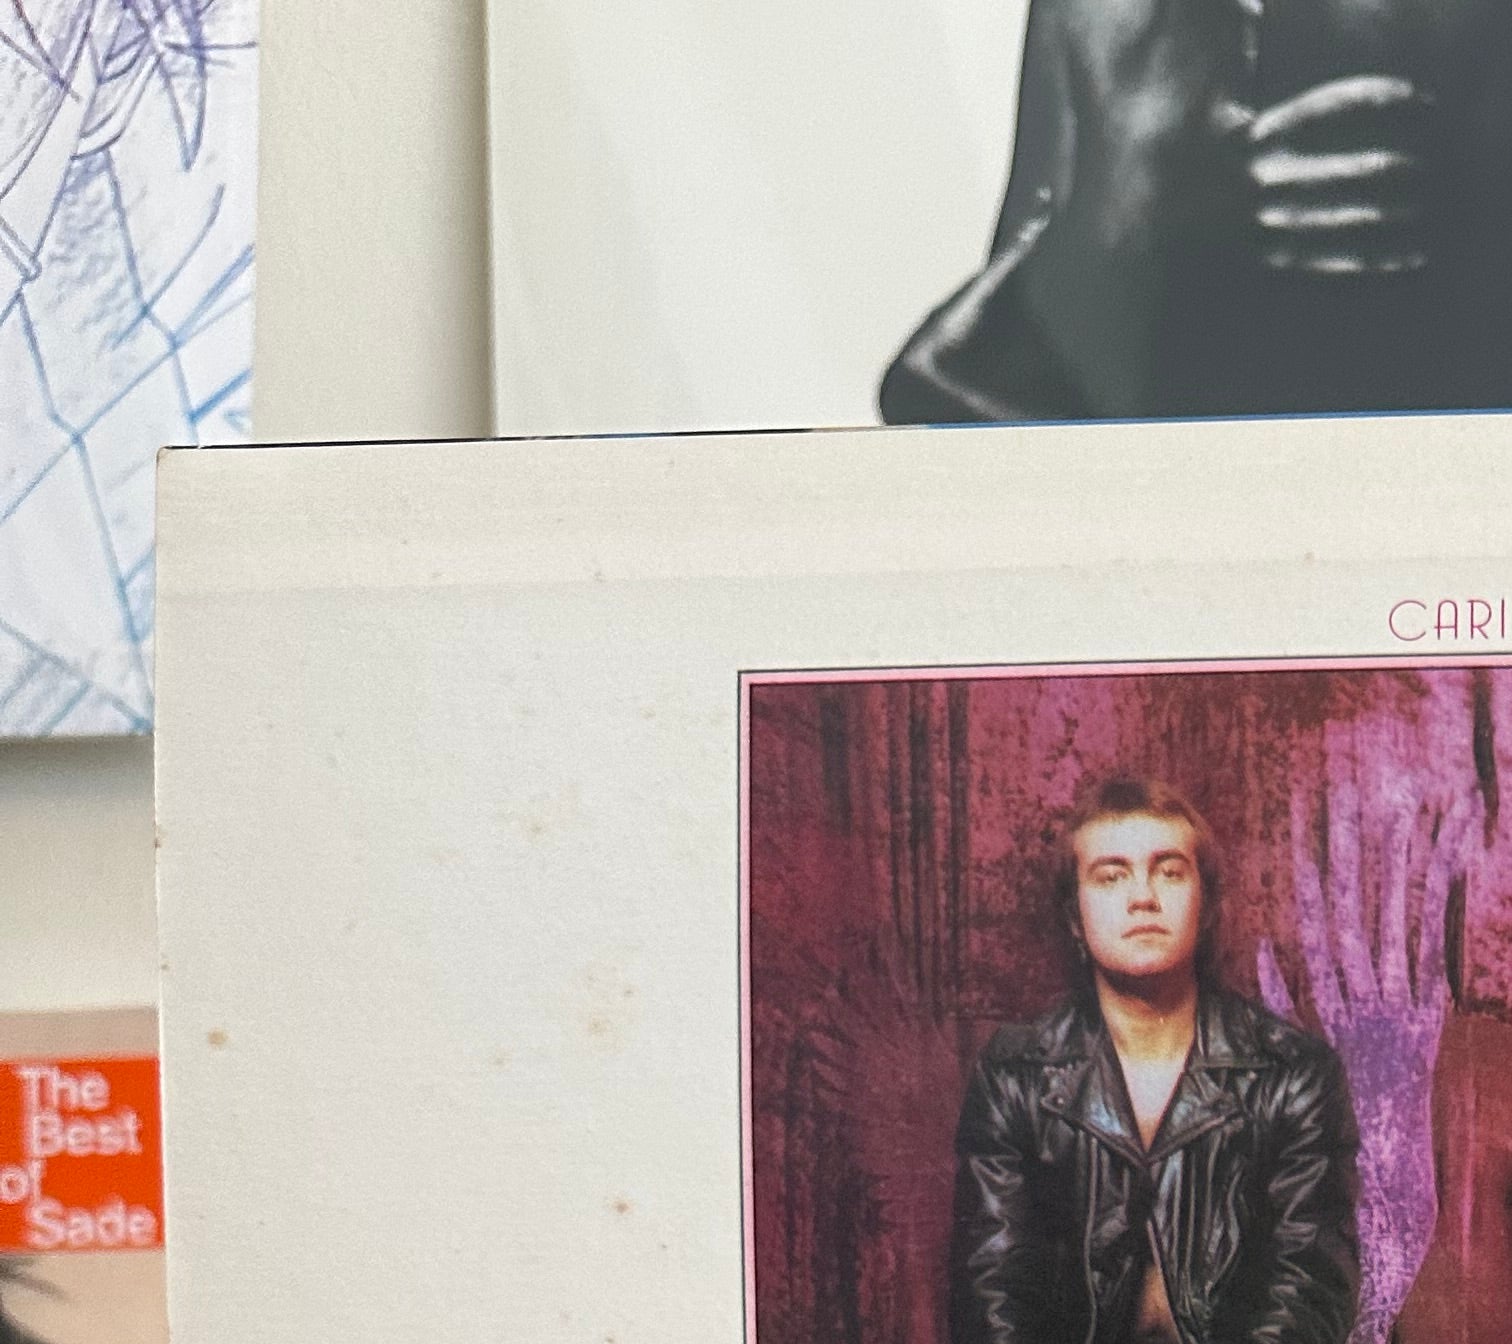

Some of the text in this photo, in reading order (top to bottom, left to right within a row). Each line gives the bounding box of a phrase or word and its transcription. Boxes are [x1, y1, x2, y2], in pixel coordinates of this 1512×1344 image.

[20, 1066, 110, 1111] The
[31, 1110, 143, 1156] Best
[27, 1198, 157, 1245] Sade
